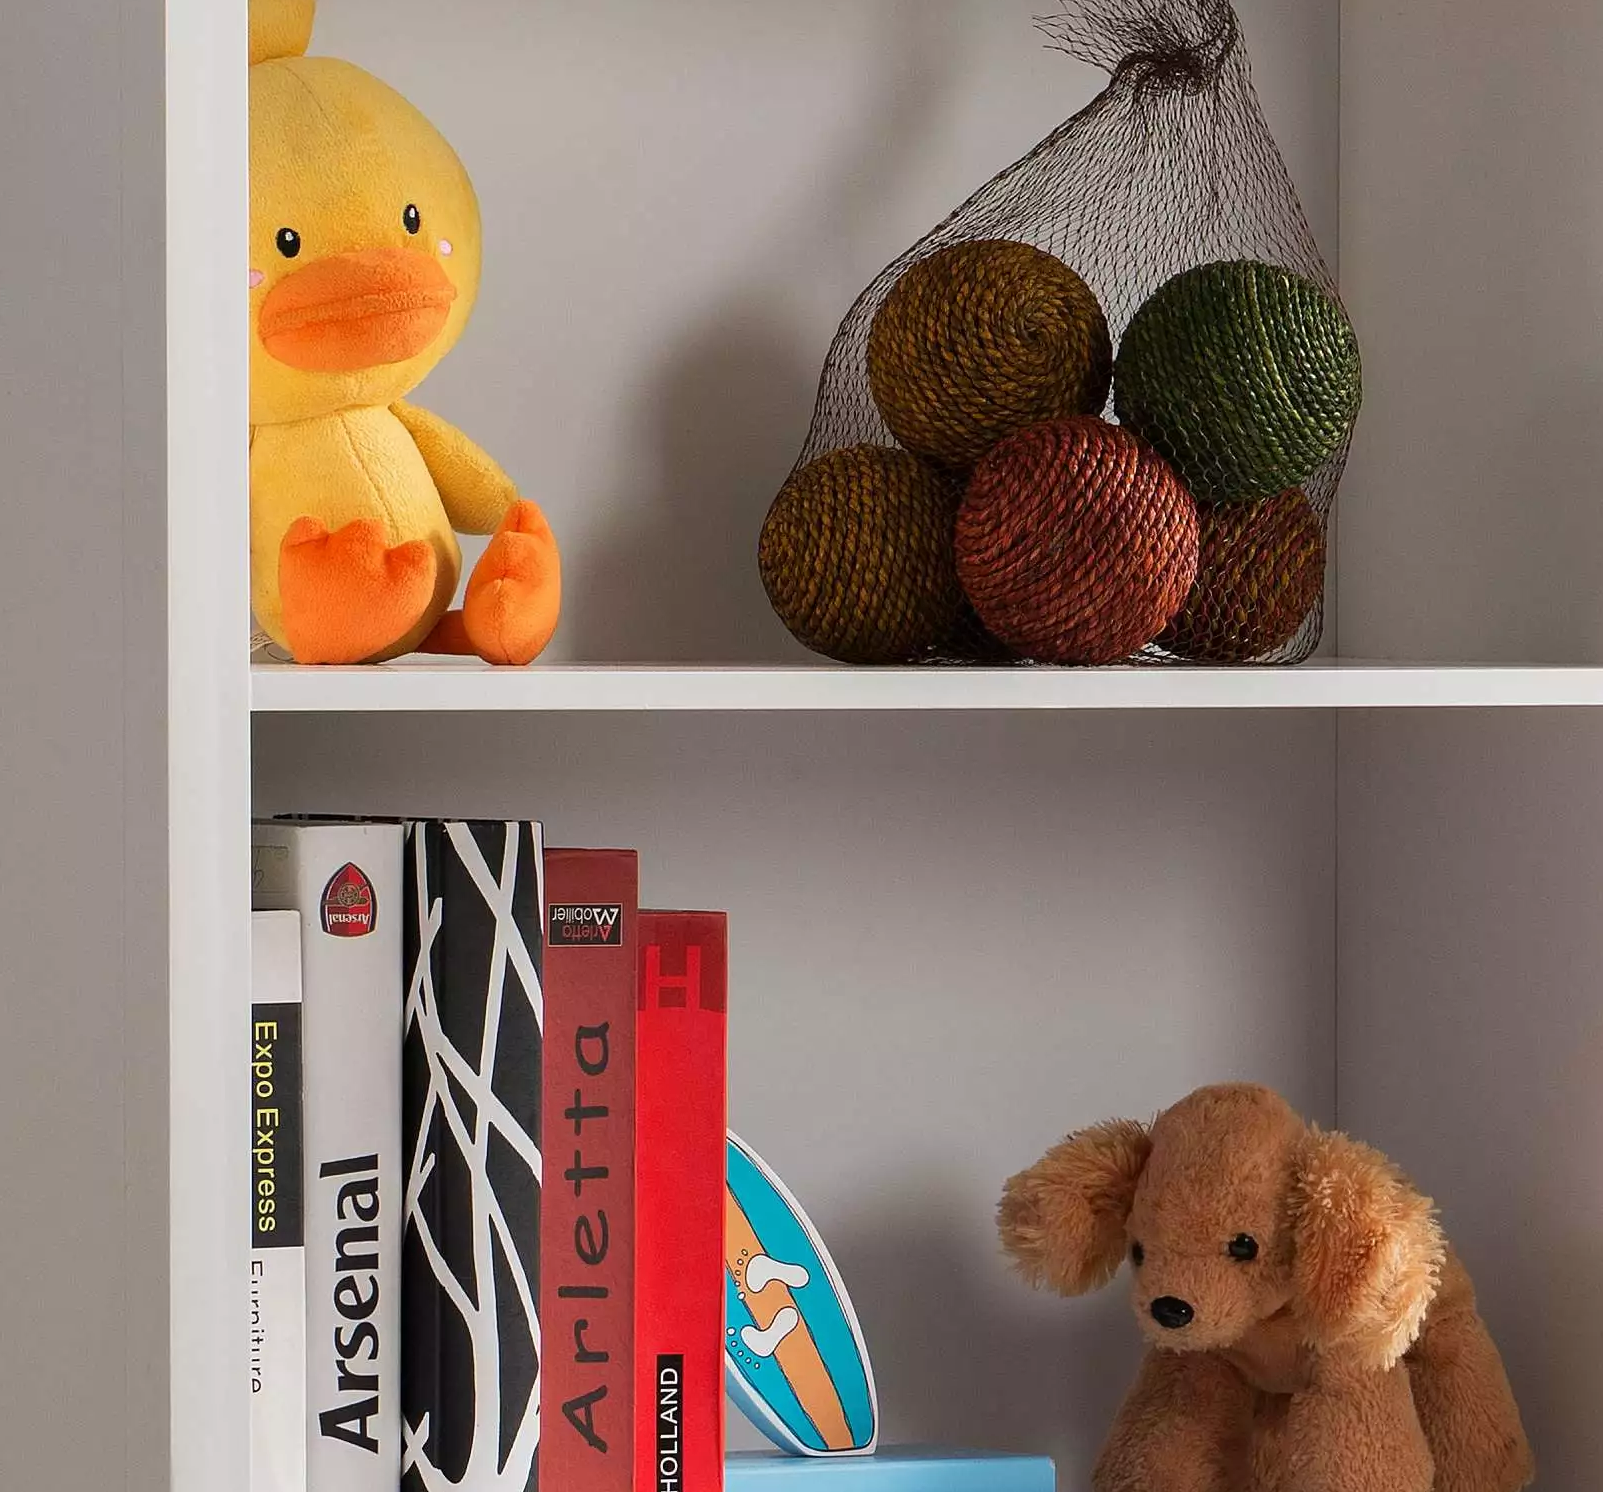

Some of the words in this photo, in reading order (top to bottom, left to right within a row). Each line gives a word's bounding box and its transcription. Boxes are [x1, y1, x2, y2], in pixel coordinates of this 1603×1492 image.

[329, 913, 370, 925] Arsenal
[552, 907, 618, 925] Mobilier
[562, 924, 612, 942] Arletta
[254, 1020, 278, 1099] Expo
[255, 1107, 279, 1233] Express
[557, 1021, 610, 1453] Arletta
[318, 1153, 380, 1455] Arsenal
